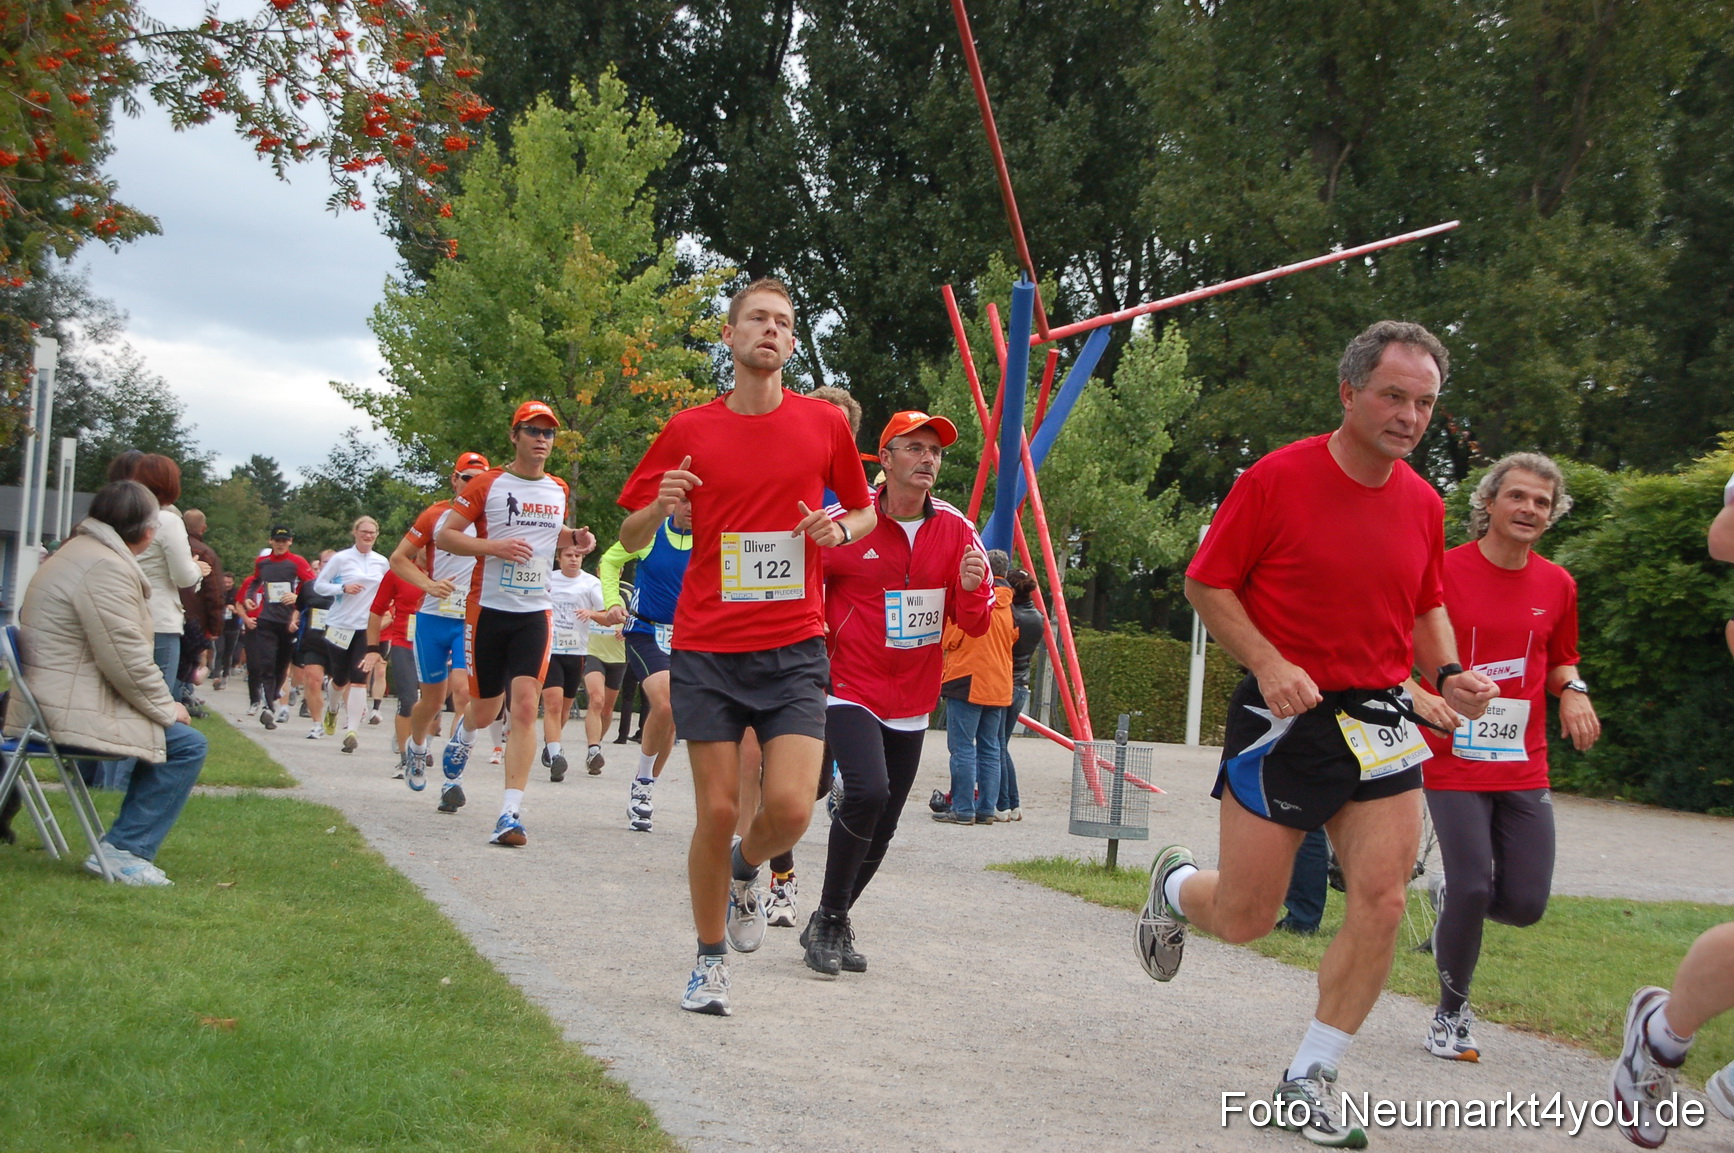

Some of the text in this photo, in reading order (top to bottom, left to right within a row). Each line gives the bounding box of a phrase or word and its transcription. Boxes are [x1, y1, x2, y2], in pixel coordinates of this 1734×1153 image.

[523, 502, 560, 515] MERZ
[520, 509, 554, 520] Reisen
[539, 521, 557, 529] 2008
[744, 540, 776, 553] Oliver
[724, 560, 731, 570] C
[753, 560, 791, 579] 122
[515, 571, 542, 582] 3321
[906, 596, 924, 606] Willi
[891, 612, 897, 621] B
[908, 610, 940, 628] 2793
[334, 630, 348, 641] 710
[465, 623, 474, 677] MERZ
[1485, 705, 1506, 716] eter
[1477, 721, 1518, 740] 2348
[1350, 736, 1359, 748] C
